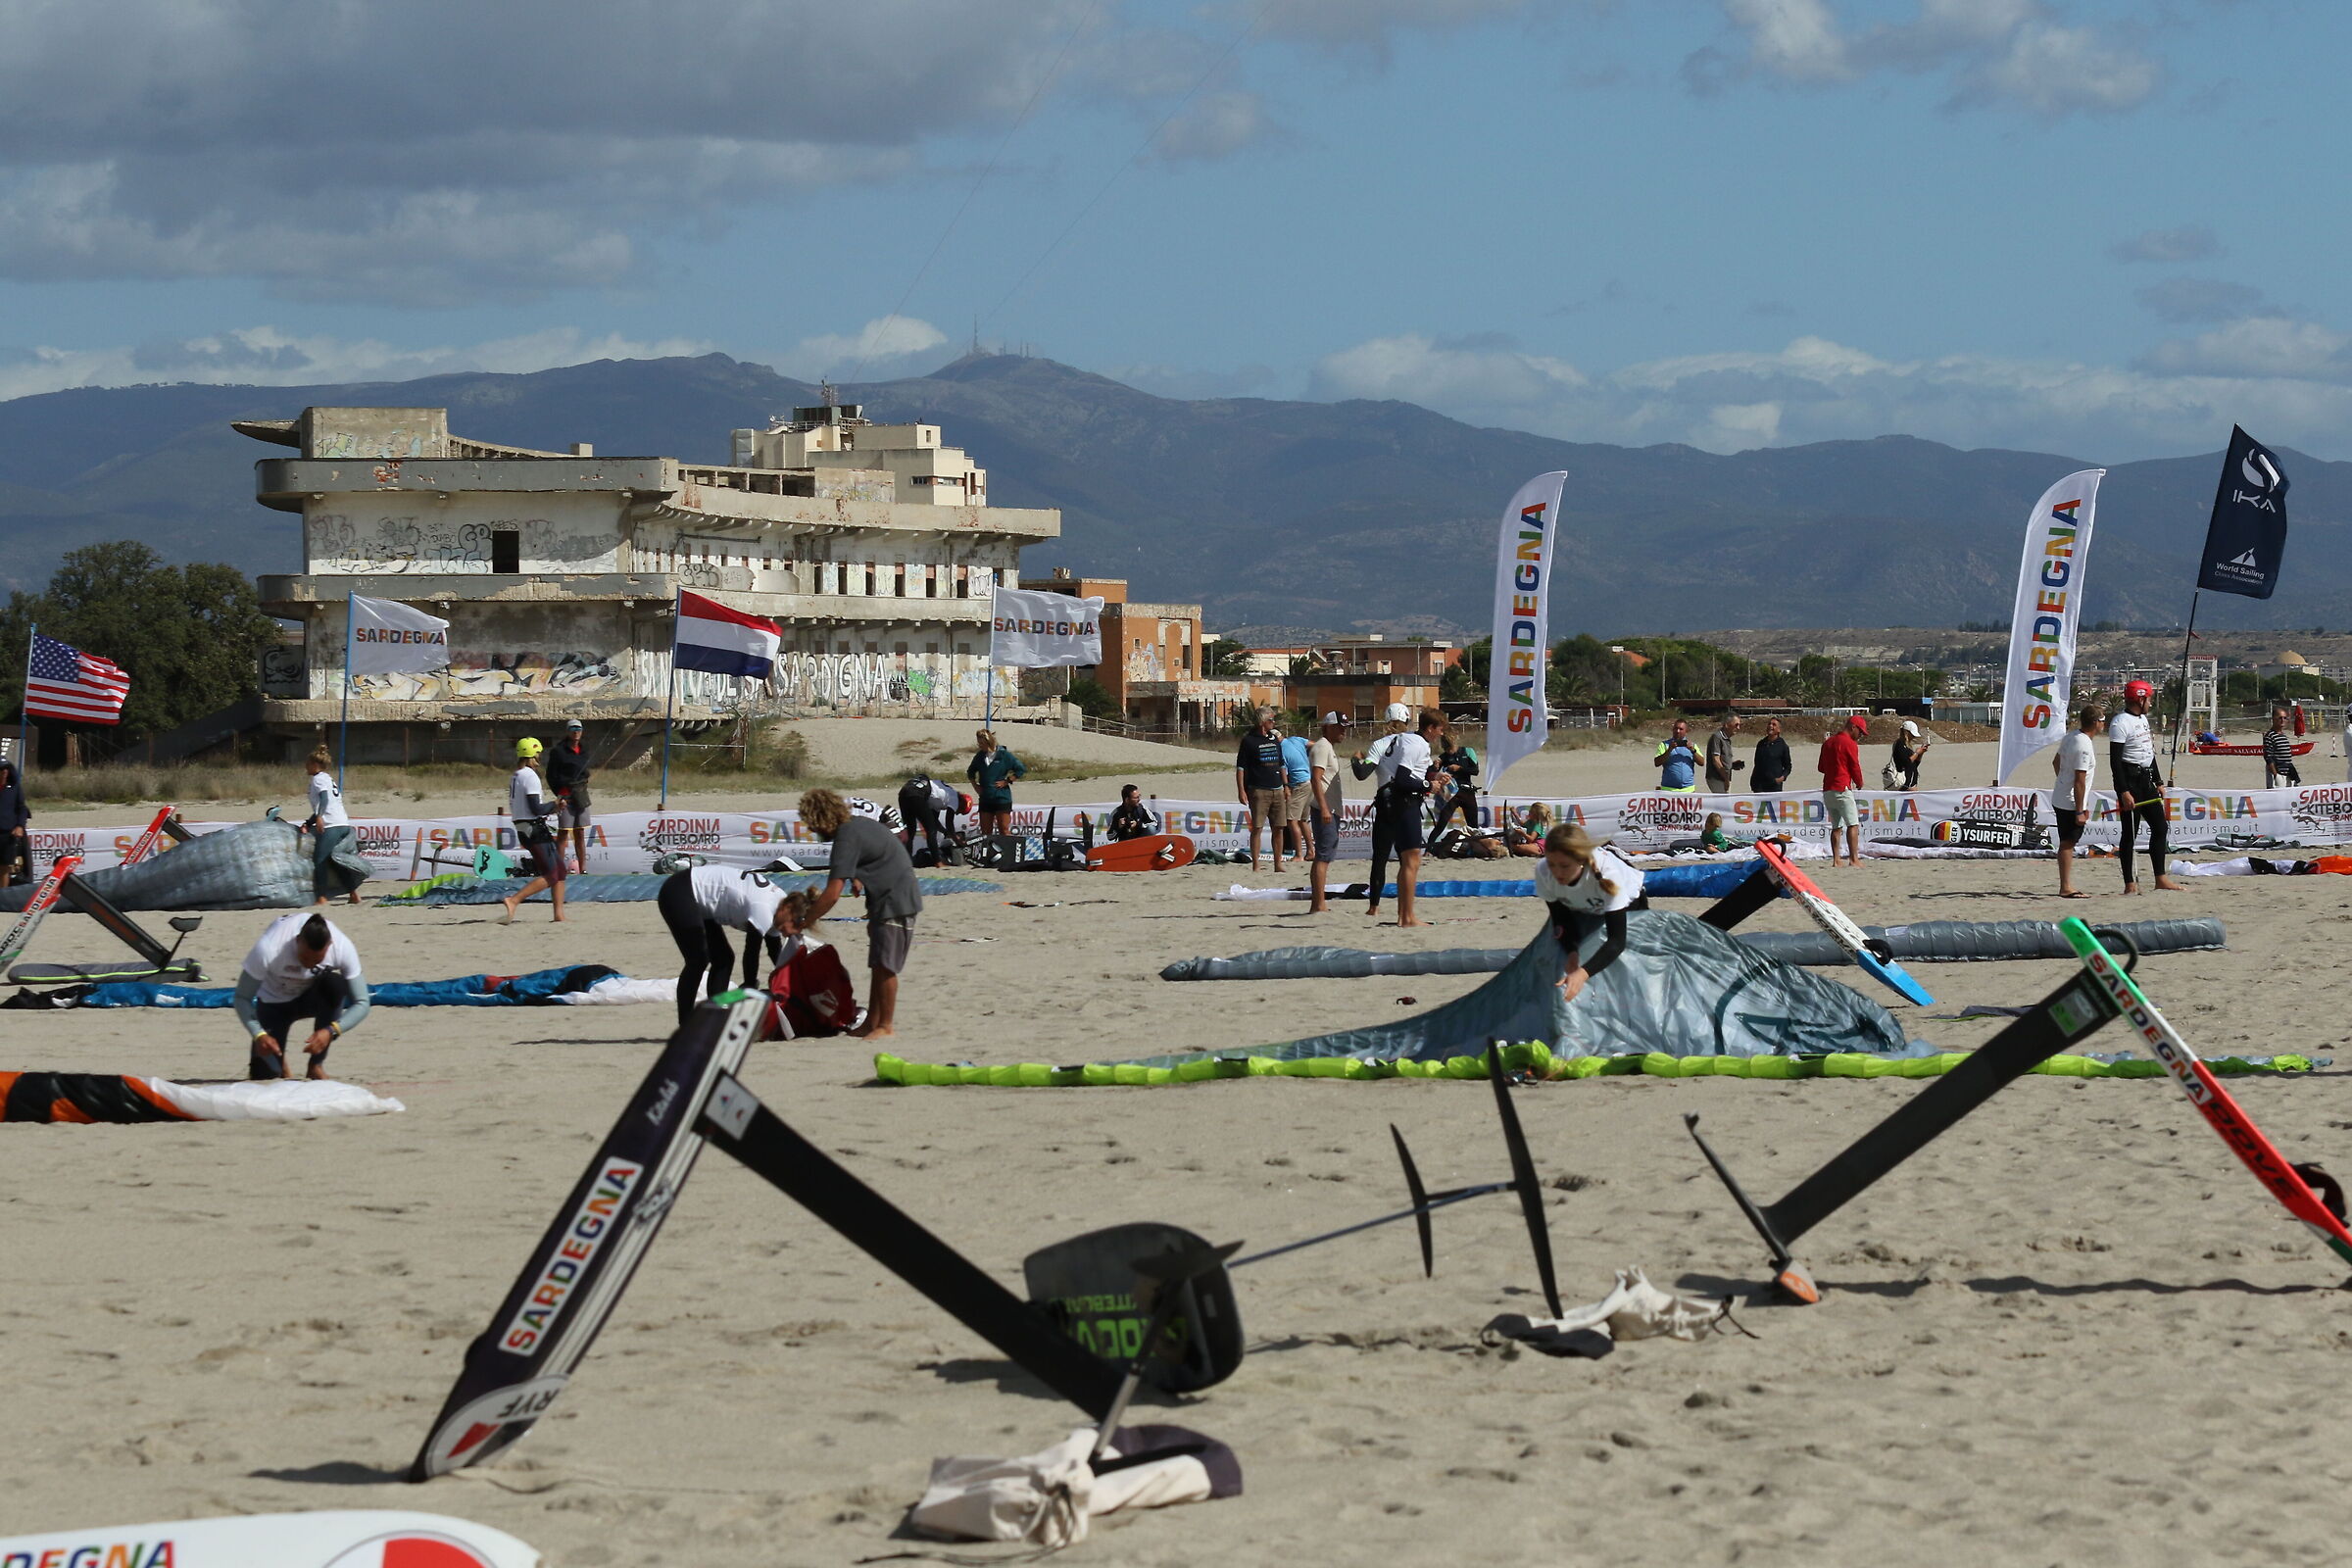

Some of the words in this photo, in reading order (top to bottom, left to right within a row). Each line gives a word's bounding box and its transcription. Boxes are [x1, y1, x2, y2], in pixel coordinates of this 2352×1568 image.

[2232, 489, 2276, 513] IKA
[2216, 563, 2238, 573] World
[2239, 567, 2265, 579] Sailing
[1507, 502, 1546, 733] SARDEGNA
[2022, 499, 2082, 729] SARDEGNA
[994, 616, 1095, 636] SARDEGNA
[357, 627, 444, 645] SARDEGNA
[1628, 798, 1702, 812] SARDINIA
[1734, 799, 1920, 823] SARDGNA
[2307, 803, 2352, 815] KITEBO
[647, 818, 720, 834] SARDINIA
[1636, 812, 1702, 824] KITEBOARD
[355, 825, 400, 840] DINIA
[656, 833, 720, 845] KITEBOARD
[30, 834, 85, 849] RDINIA
[361, 840, 400, 851] BOARD
[2089, 953, 2205, 1101] SARDEGNA
[507, 1167, 636, 1350] SARDEGNA
